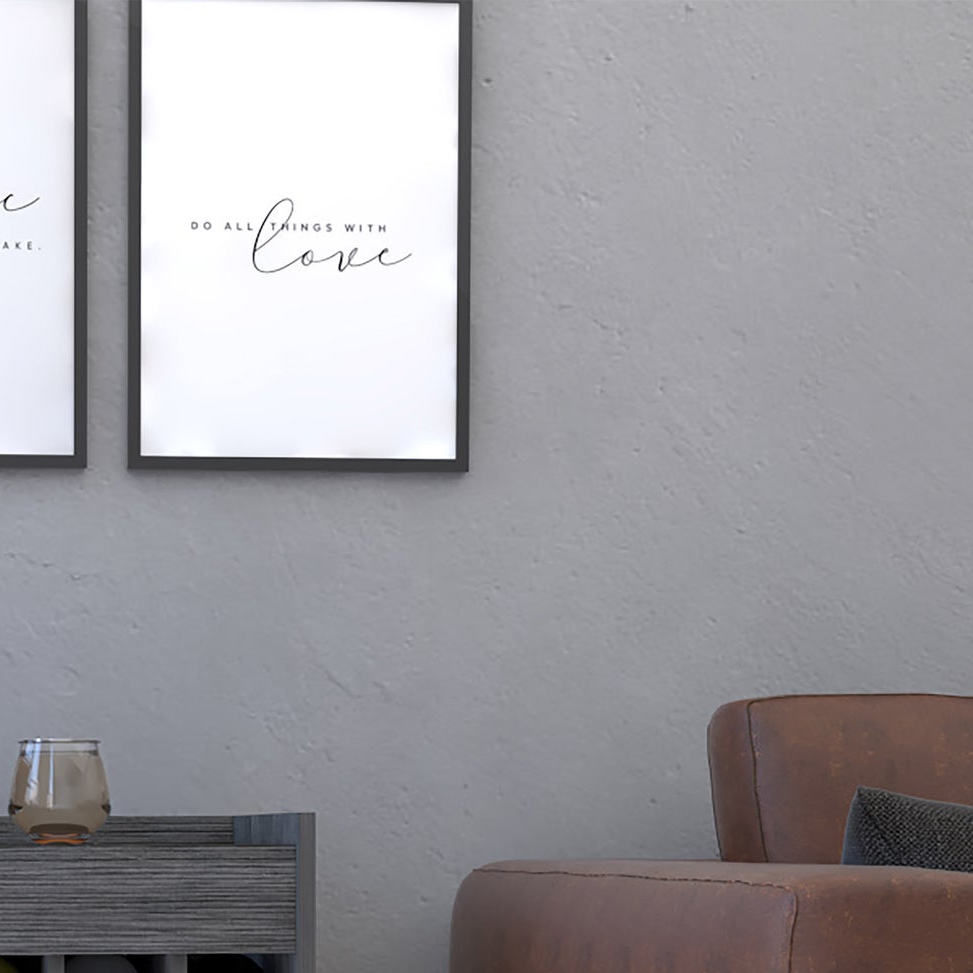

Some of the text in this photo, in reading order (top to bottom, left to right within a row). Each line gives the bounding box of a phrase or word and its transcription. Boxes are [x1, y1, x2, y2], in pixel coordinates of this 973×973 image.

[190, 221, 387, 233] DO ALL THINGS WITH
